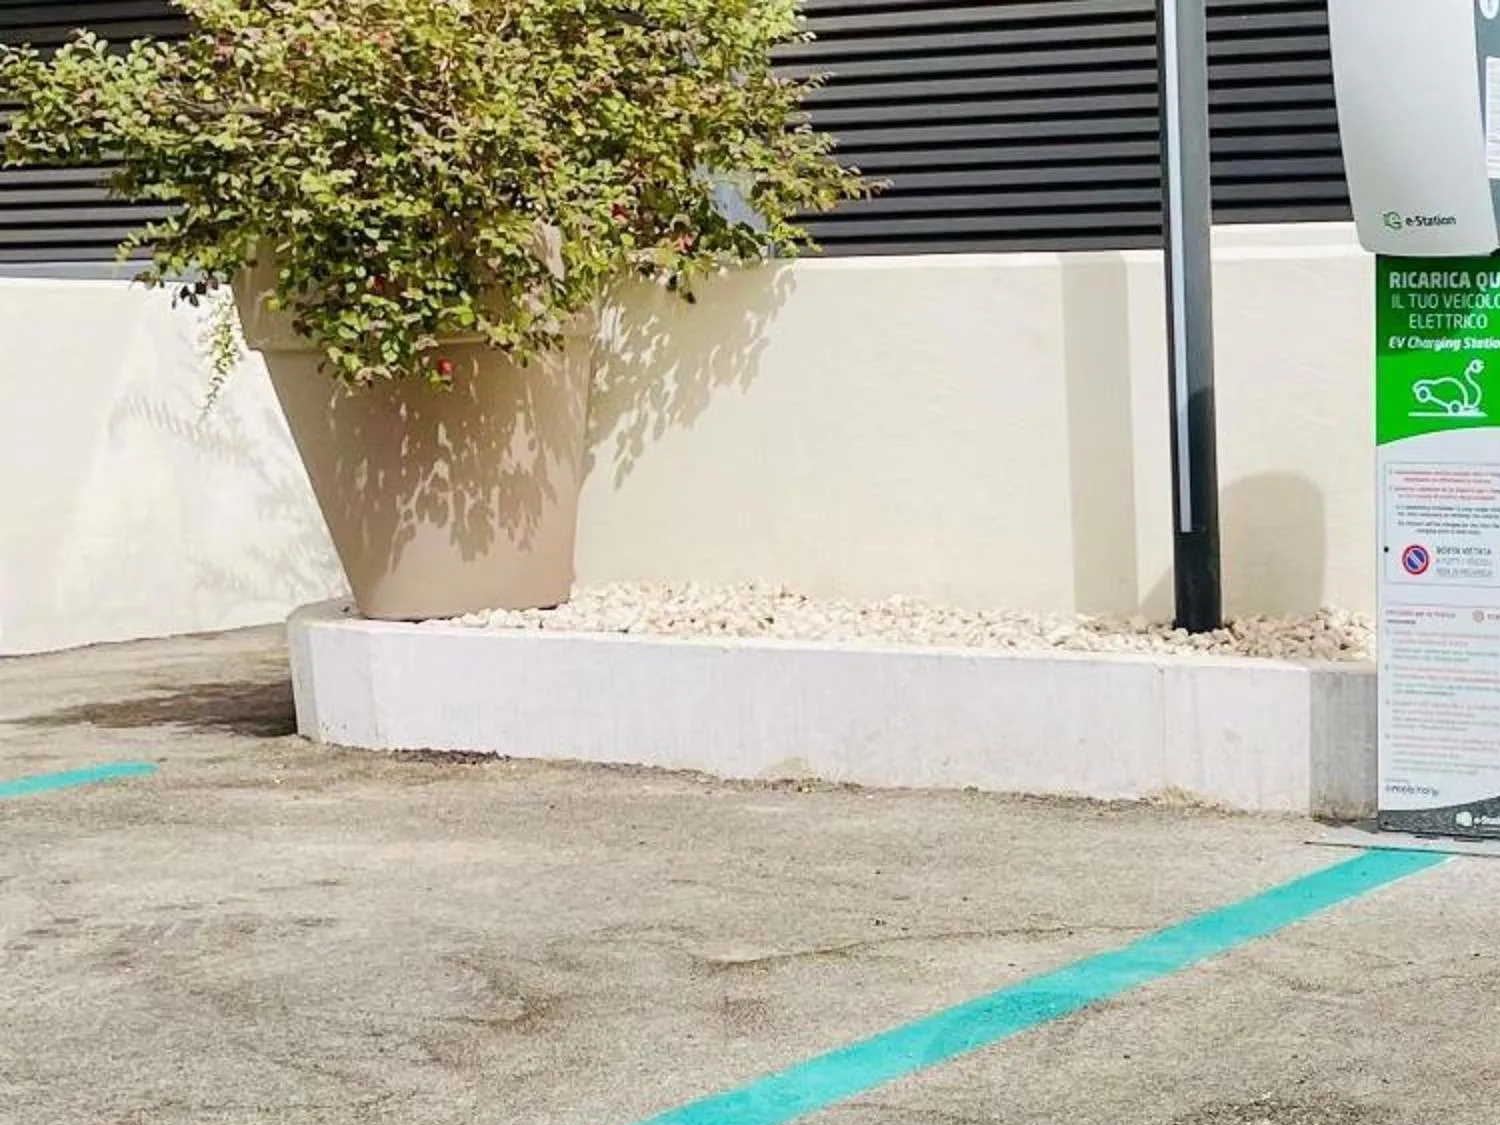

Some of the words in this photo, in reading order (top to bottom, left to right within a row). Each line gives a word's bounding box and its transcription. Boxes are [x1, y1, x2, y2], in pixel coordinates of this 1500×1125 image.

[1405, 214, 1457, 226] e-Station
[1389, 271, 1470, 289] RICARICA
[1391, 293, 1405, 309] IL
[1409, 293, 1438, 309] TUO
[1409, 313, 1488, 329] ELETTRICO
[1388, 336, 1406, 349] EV
[1407, 336, 1461, 352] Charging
